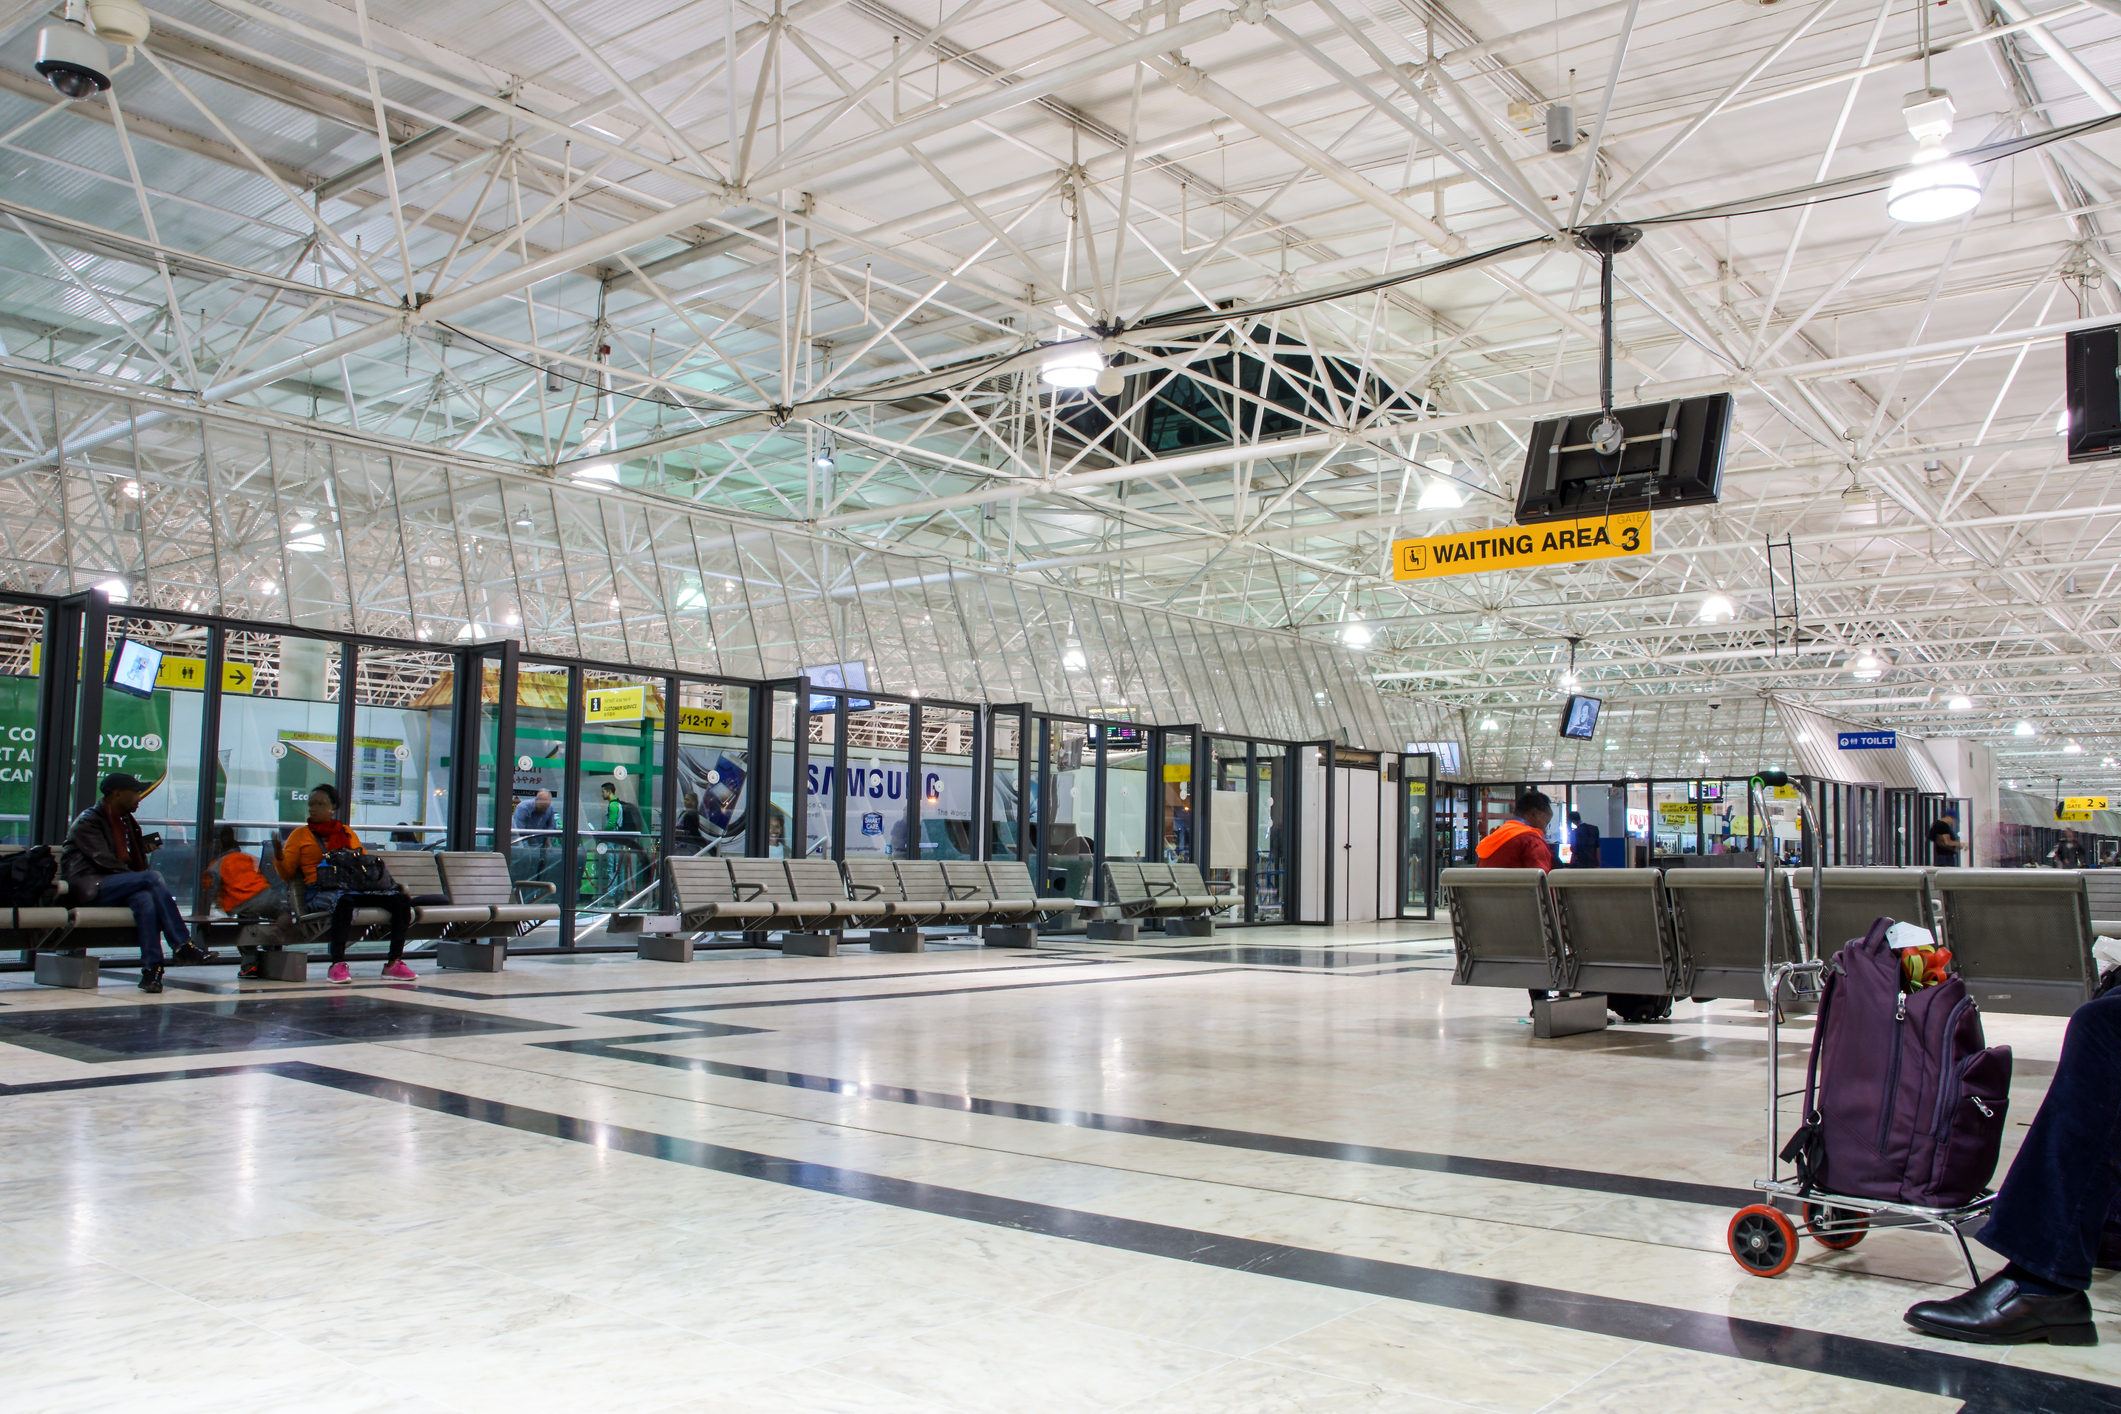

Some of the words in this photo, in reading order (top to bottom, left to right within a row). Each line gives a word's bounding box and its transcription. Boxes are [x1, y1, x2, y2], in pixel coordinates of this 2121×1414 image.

[1618, 513, 1643, 525] GATE
[1433, 534, 1533, 564] WAITING
[1541, 526, 1611, 552] AREA
[1622, 527, 1640, 552] 3
[679, 714, 715, 727] /12-17
[8, 727, 36, 742] CO
[1861, 737, 1895, 745] TOILET
[2087, 799, 2094, 807] 2
